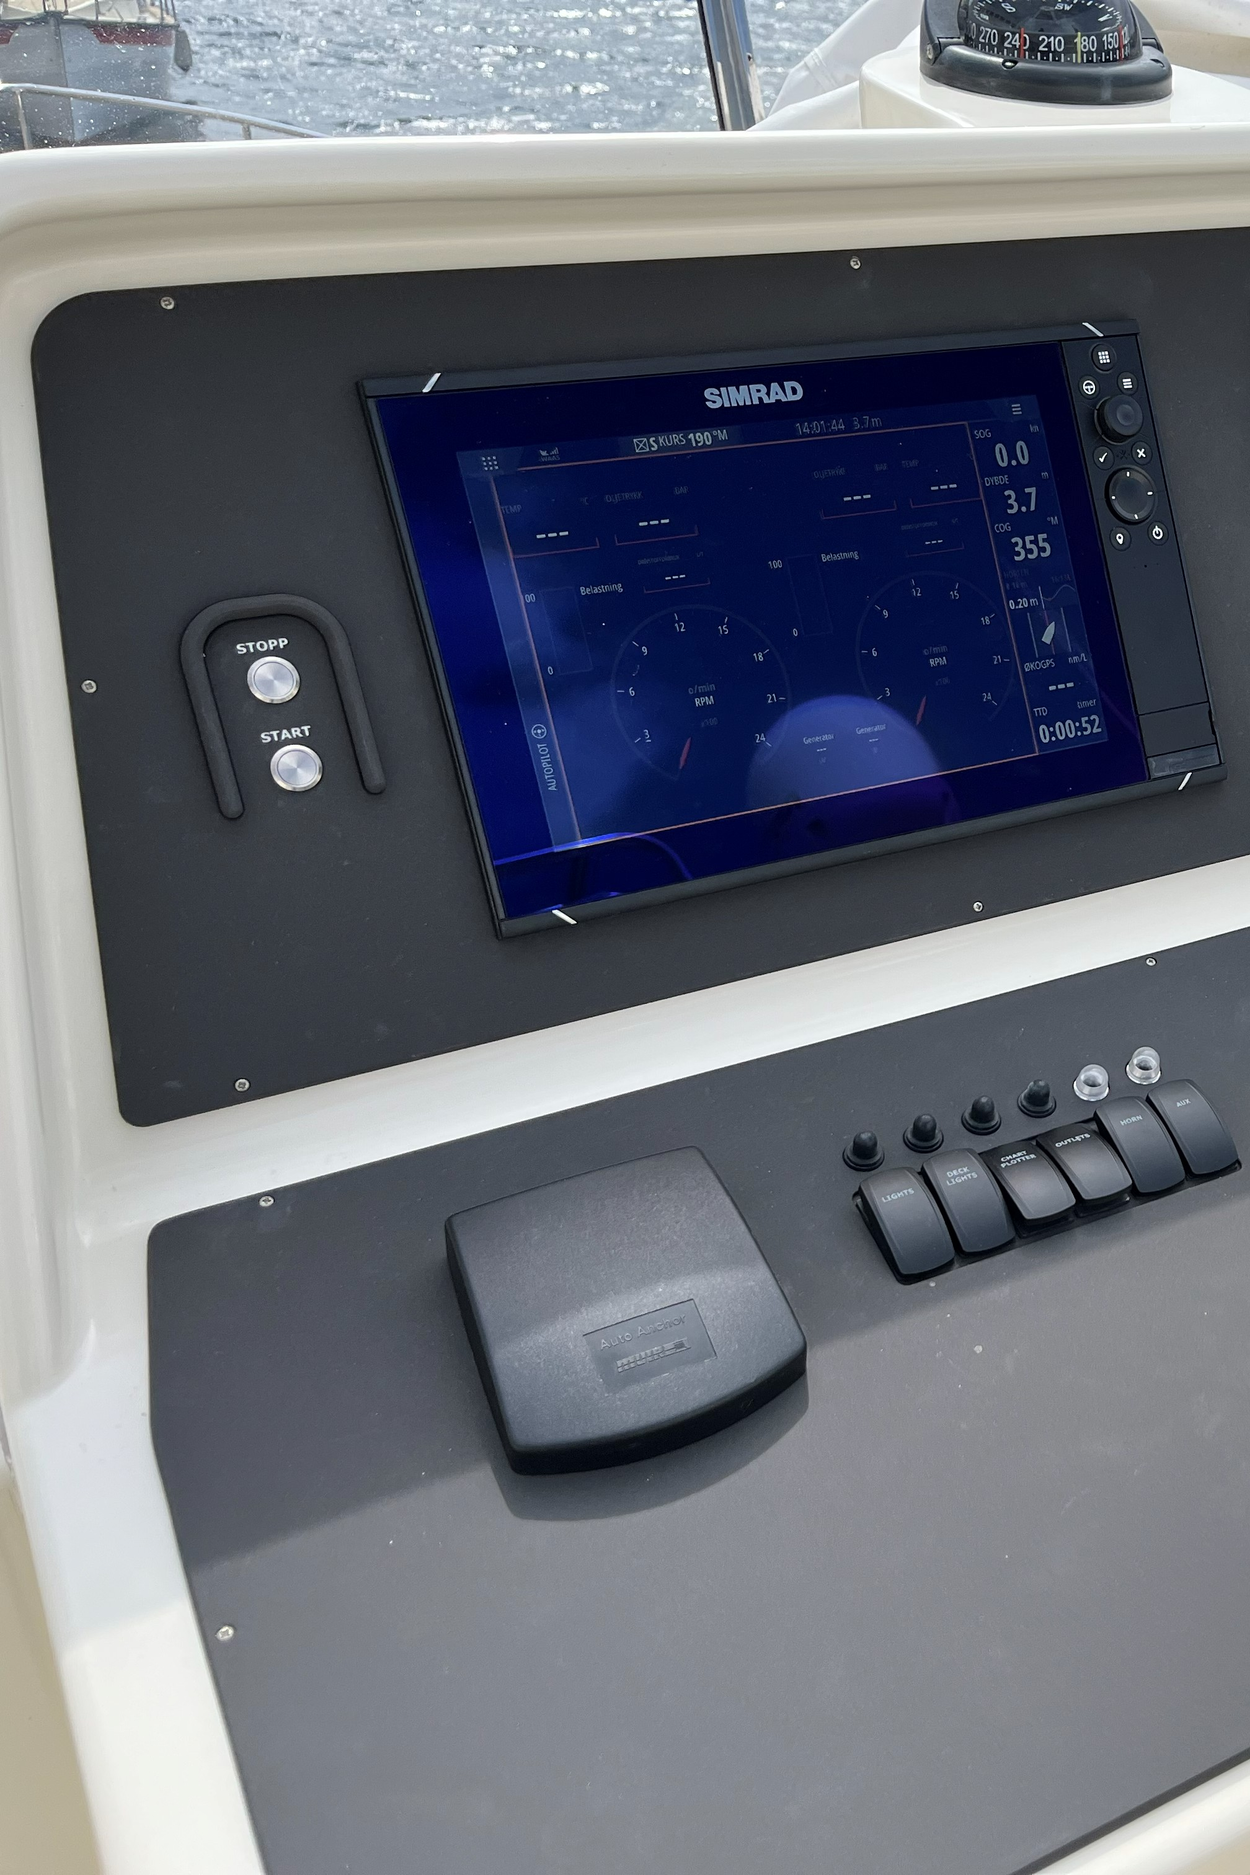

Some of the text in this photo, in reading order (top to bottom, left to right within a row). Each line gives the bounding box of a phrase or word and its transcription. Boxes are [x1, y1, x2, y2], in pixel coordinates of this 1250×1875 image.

[979, 26, 998, 45] 270
[1004, 32, 1029, 49] 240
[1039, 36, 1064, 51] 210
[1102, 32, 1119, 50] 150
[704, 381, 803, 408] SIMRAD
[796, 419, 845, 435] 14:01:44
[659, 433, 686, 448] KURS
[688, 431, 712, 447] 190
[974, 429, 991, 439] SOG
[995, 440, 1029, 468] 0.0
[984, 475, 1009, 487] DYBDE
[1004, 487, 1038, 514] 3.7
[994, 522, 1011, 534] COG
[1011, 534, 1051, 561] 355
[821, 551, 859, 563] Belastning
[768, 560, 783, 569] 100
[580, 582, 623, 596] Belastning
[912, 587, 922, 597] 12
[950, 590, 960, 599] 15
[1009, 598, 1028, 610] 0.20
[883, 610, 889, 618] 9
[981, 616, 990, 625] 18
[674, 622, 686, 632] 12
[718, 625, 729, 635] 15
[236, 637, 288, 654] STOPP
[642, 646, 648, 655] 9
[753, 652, 764, 662] 18
[872, 647, 878, 657] 6
[930, 656, 947, 668] RPM
[993, 655, 1001, 664] 21
[629, 687, 635, 696] 6
[885, 687, 890, 697] 3
[982, 693, 992, 702] 24
[695, 696, 715, 707] RPM
[767, 694, 777, 703] 21
[1033, 707, 1048, 717] TTD
[260, 725, 311, 743] START
[856, 723, 886, 735] Generator
[1039, 715, 1101, 744] 0:00:52
[755, 733, 766, 743] 24
[803, 732, 835, 744] Generator
[537, 743, 557, 791] AUTOPILOT
[1176, 1098, 1191, 1108] AUX
[1120, 1114, 1143, 1126] HORN
[1055, 1132, 1091, 1148] OUTLETS
[1000, 1152, 1037, 1168] PLOTTER
[1001, 1150, 1027, 1163] CHART
[947, 1166, 970, 1178] DECK
[946, 1171, 978, 1186] LIGHTS
[882, 1187, 915, 1203] LIGHTS
[600, 1315, 686, 1351] Auto Anchor
